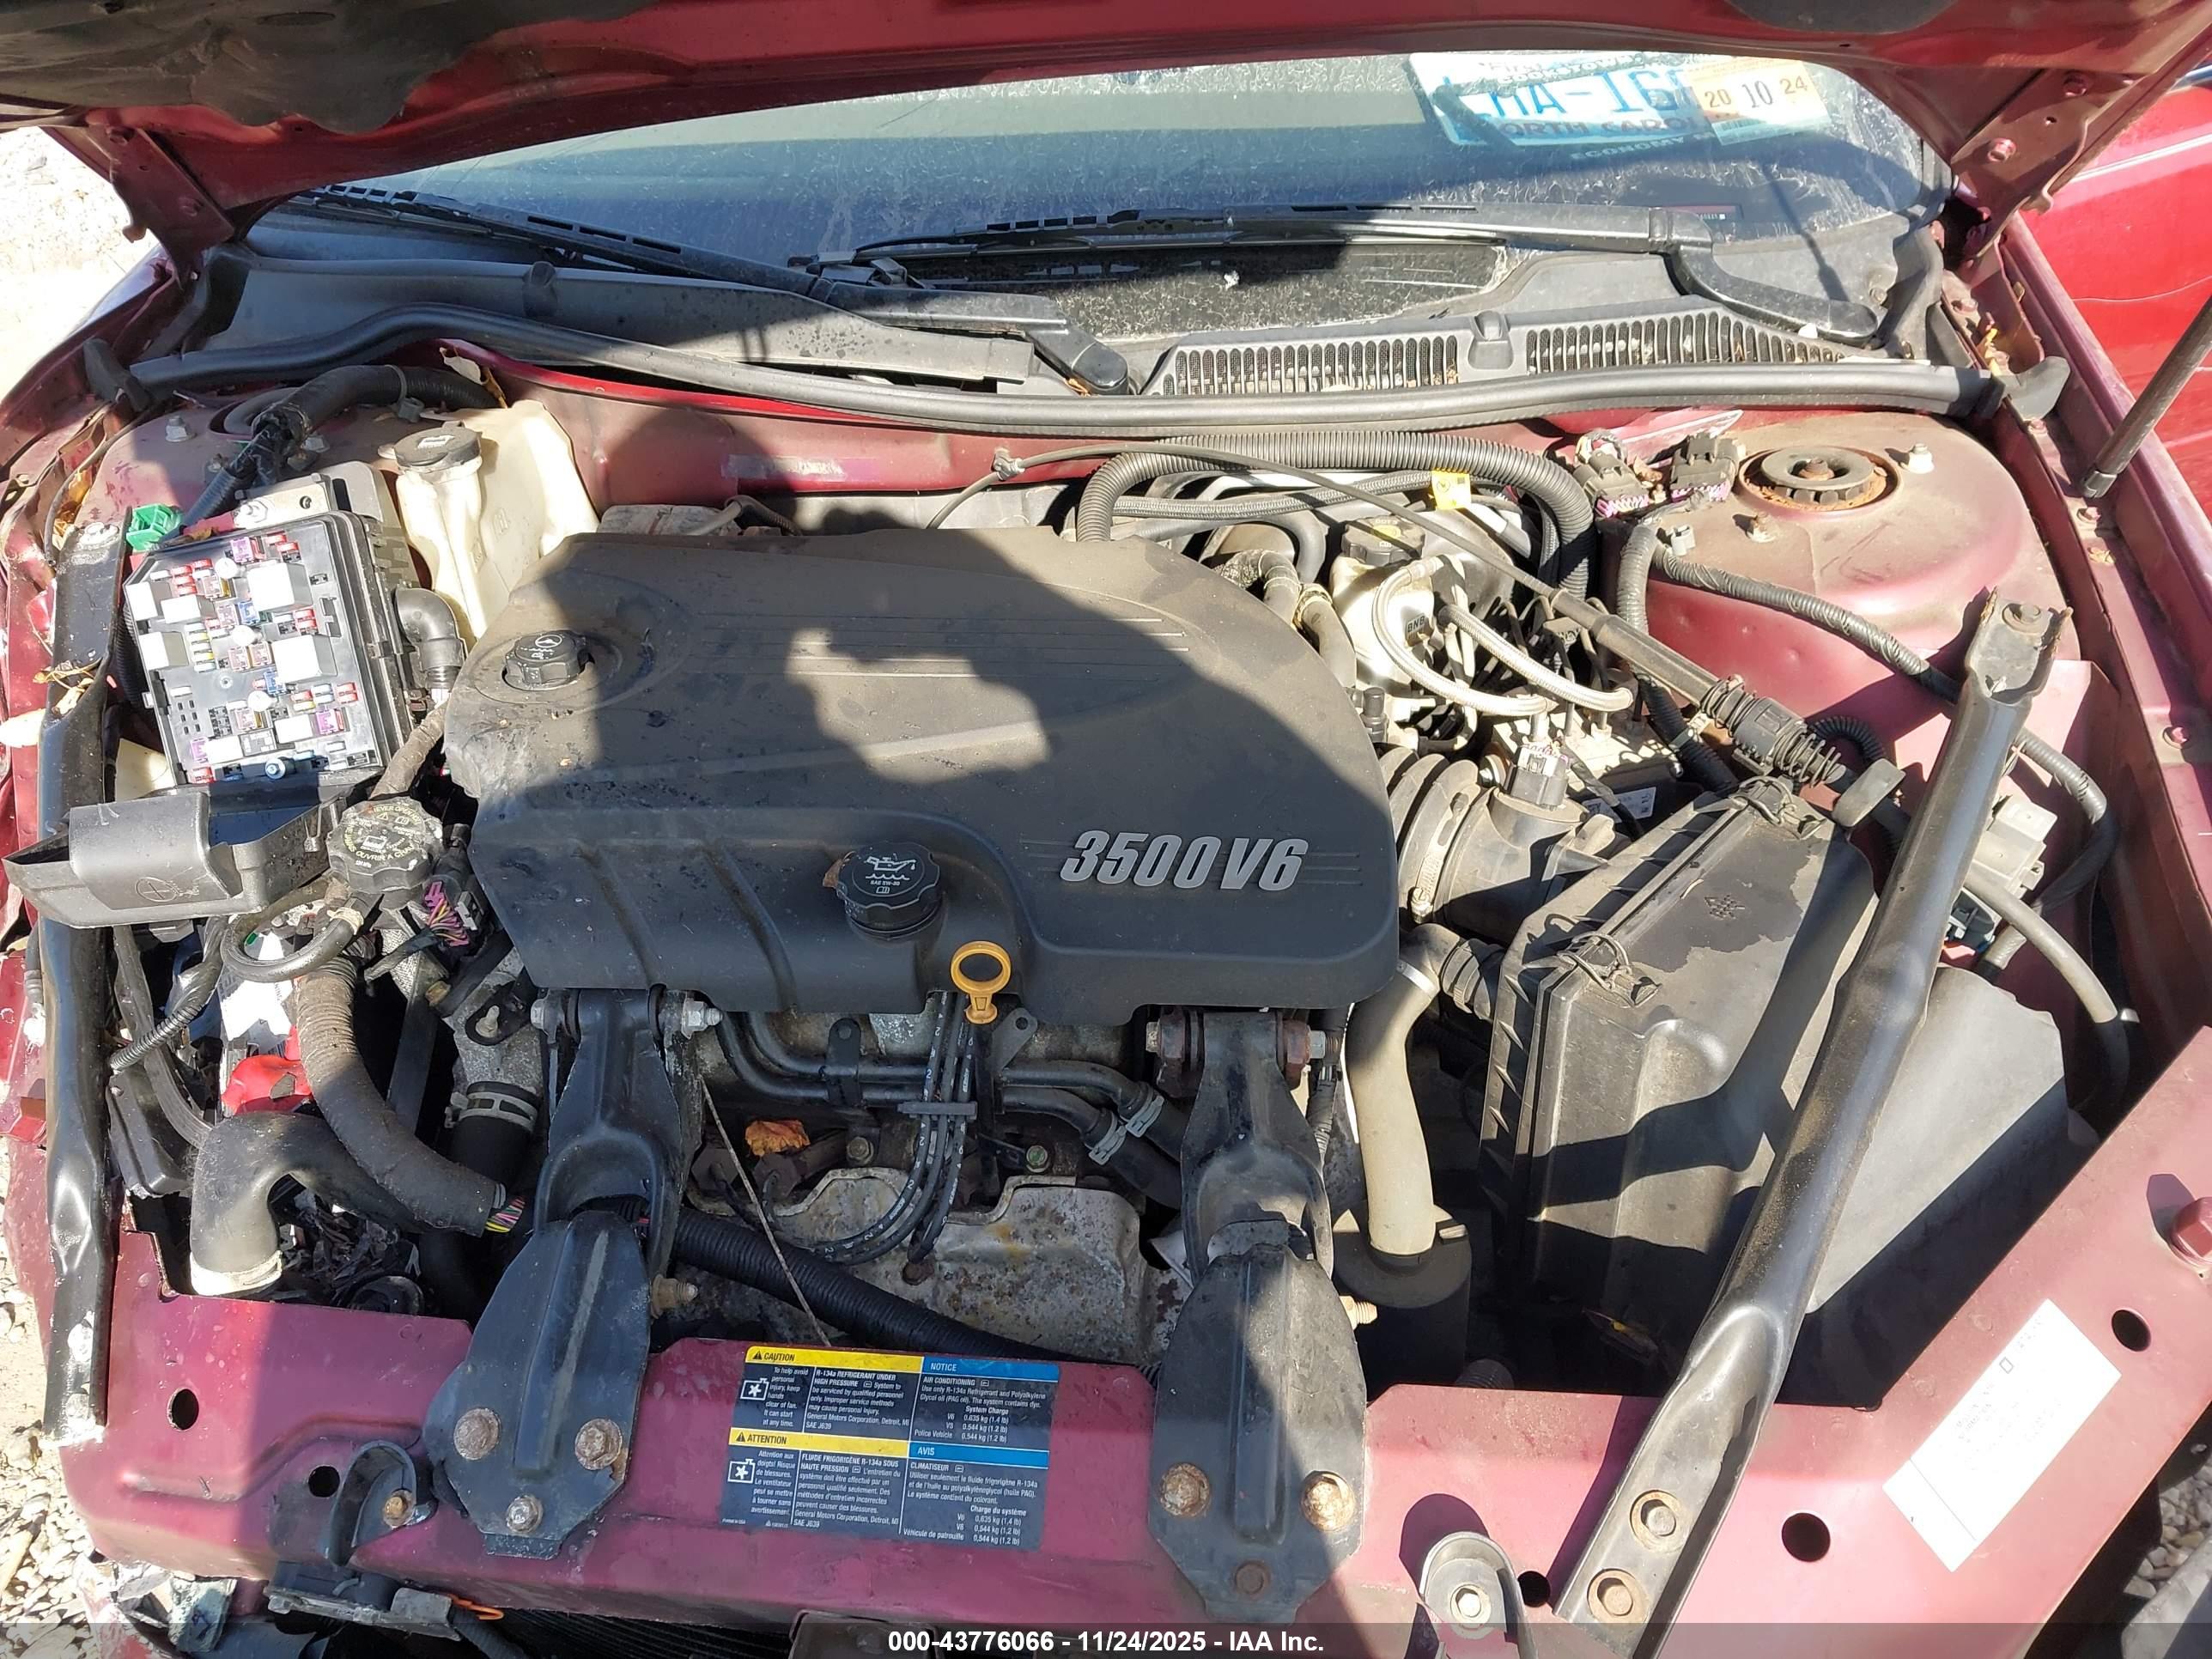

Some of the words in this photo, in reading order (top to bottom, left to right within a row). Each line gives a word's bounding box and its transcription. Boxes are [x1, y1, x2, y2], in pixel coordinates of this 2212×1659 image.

[1705, 89, 1731, 107] 20
[1742, 81, 1773, 107] 10
[1779, 76, 1808, 94] 24
[763, 1352, 795, 1361] CAUTION
[931, 1363, 957, 1371] NOTICE
[837, 1370, 875, 1379] REFRIGERANT
[934, 1377, 975, 1386] CONDITIONING
[968, 1389, 998, 1397] Refrigerant
[747, 1434, 787, 1444] ATTENTION
[915, 1428, 931, 1437] Police
[933, 1430, 952, 1438] Vehicle
[978, 1433, 986, 1442] kg
[758, 1450, 782, 1459] Attention
[802, 1454, 822, 1462] FLUIDE
[818, 1463, 849, 1473] PRESSION
[910, 1462, 949, 1471] CLIMATISEUR
[970, 1504, 991, 1514] Charge
[795, 1509, 816, 1517] General
[817, 1510, 835, 1519] Motors
[993, 1516, 1000, 1525] kg
[992, 1526, 999, 1534] kg
[991, 1536, 998, 1545] kg
